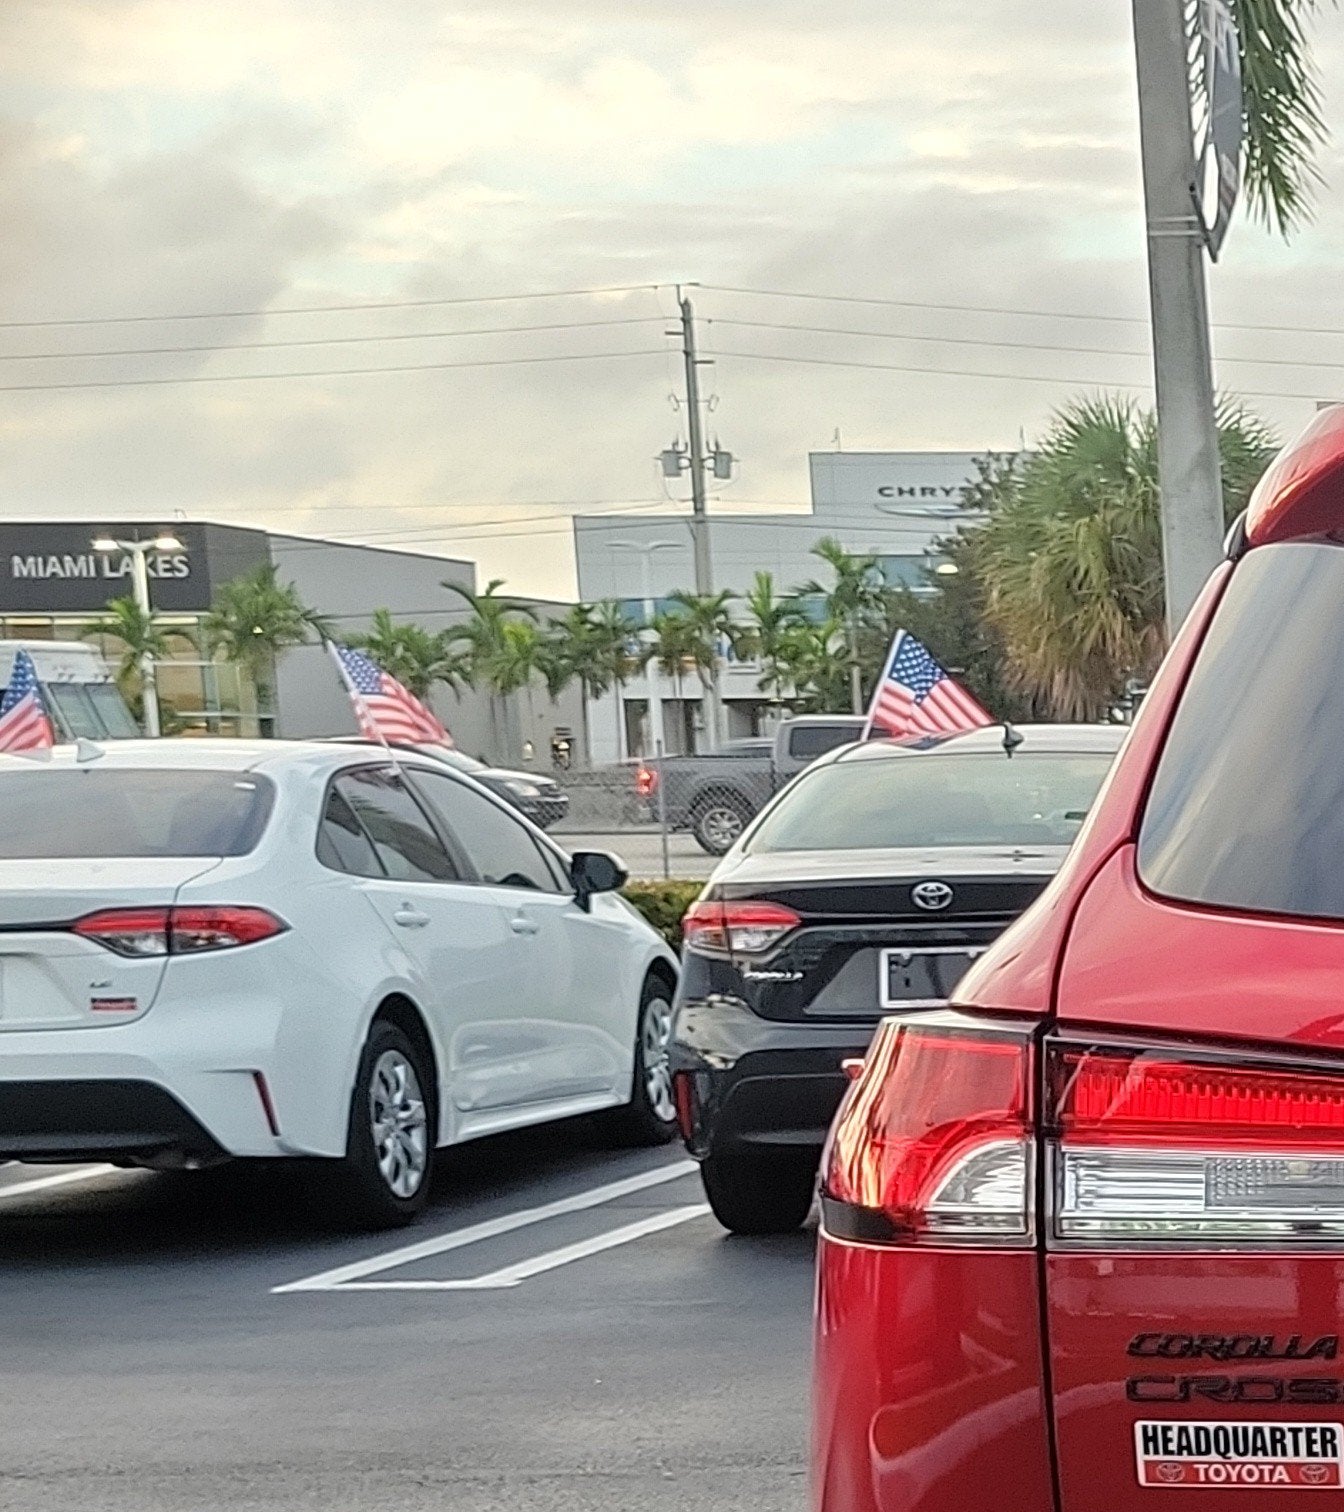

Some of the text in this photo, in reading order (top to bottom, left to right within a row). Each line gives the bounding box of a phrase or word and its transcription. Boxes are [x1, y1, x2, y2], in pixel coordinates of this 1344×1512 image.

[12, 555, 190, 578] MIAMI LAKES
[1127, 1333, 1339, 1360] COROLLA
[1142, 1424, 1339, 1459] HEADQUARTER
[1193, 1463, 1291, 1484] TOYOTA
